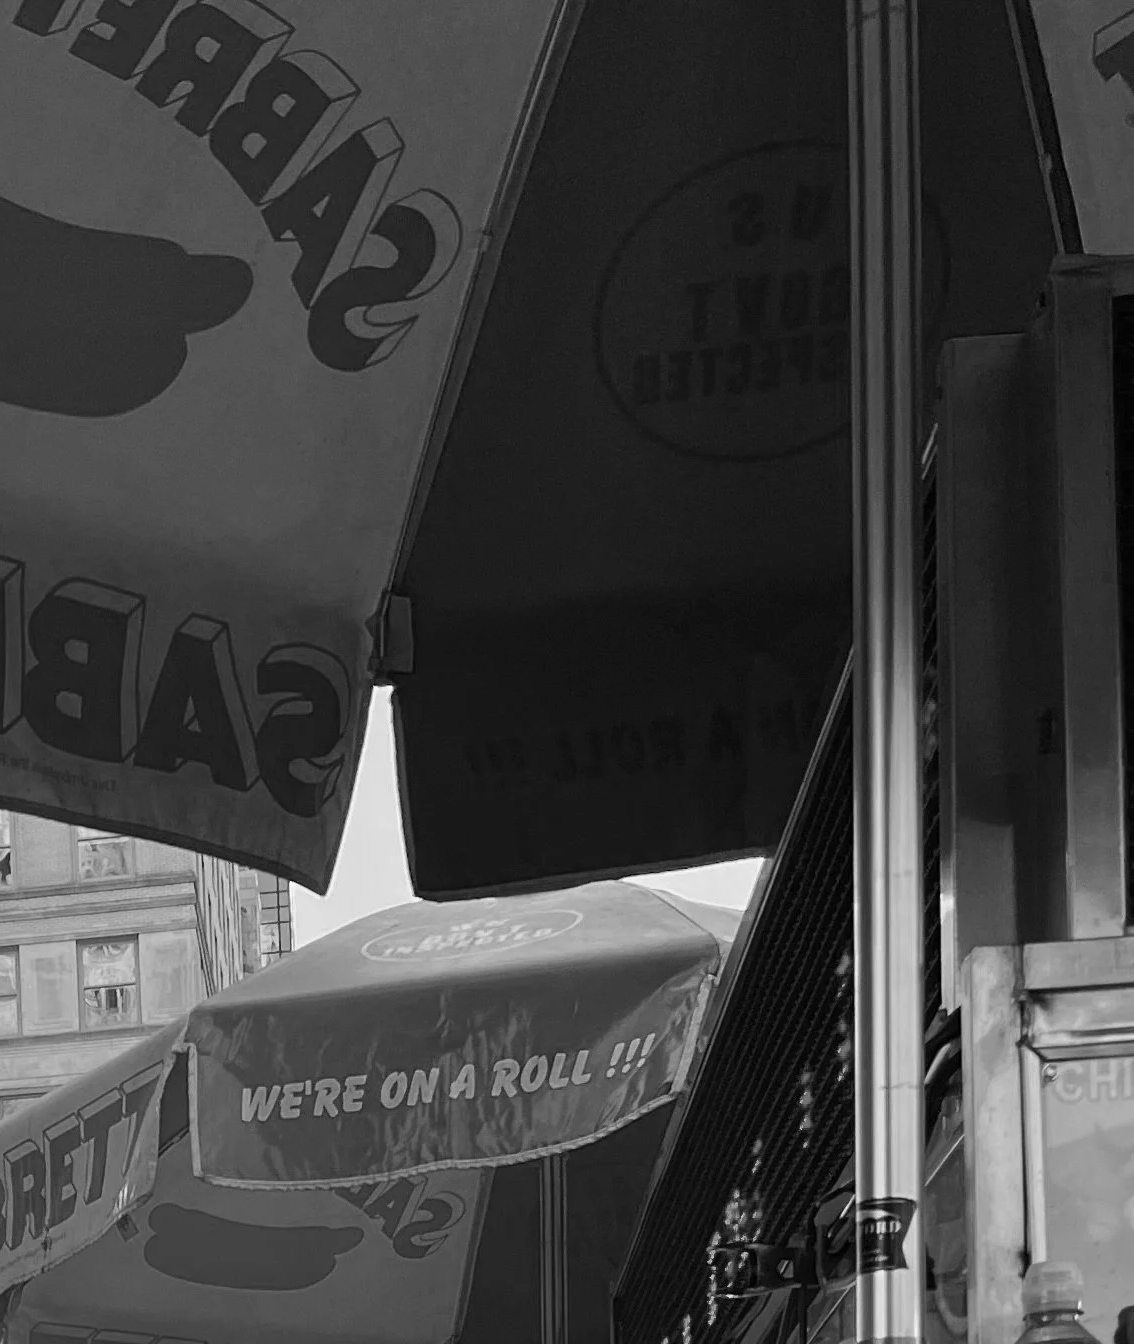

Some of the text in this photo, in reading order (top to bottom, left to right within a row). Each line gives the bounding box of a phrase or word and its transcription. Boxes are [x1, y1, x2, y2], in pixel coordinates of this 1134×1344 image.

[241, 1075, 367, 1122] WE'RE
[381, 1067, 439, 1109] ON
[449, 1064, 475, 1099] A
[491, 1050, 591, 1098] ROLL
